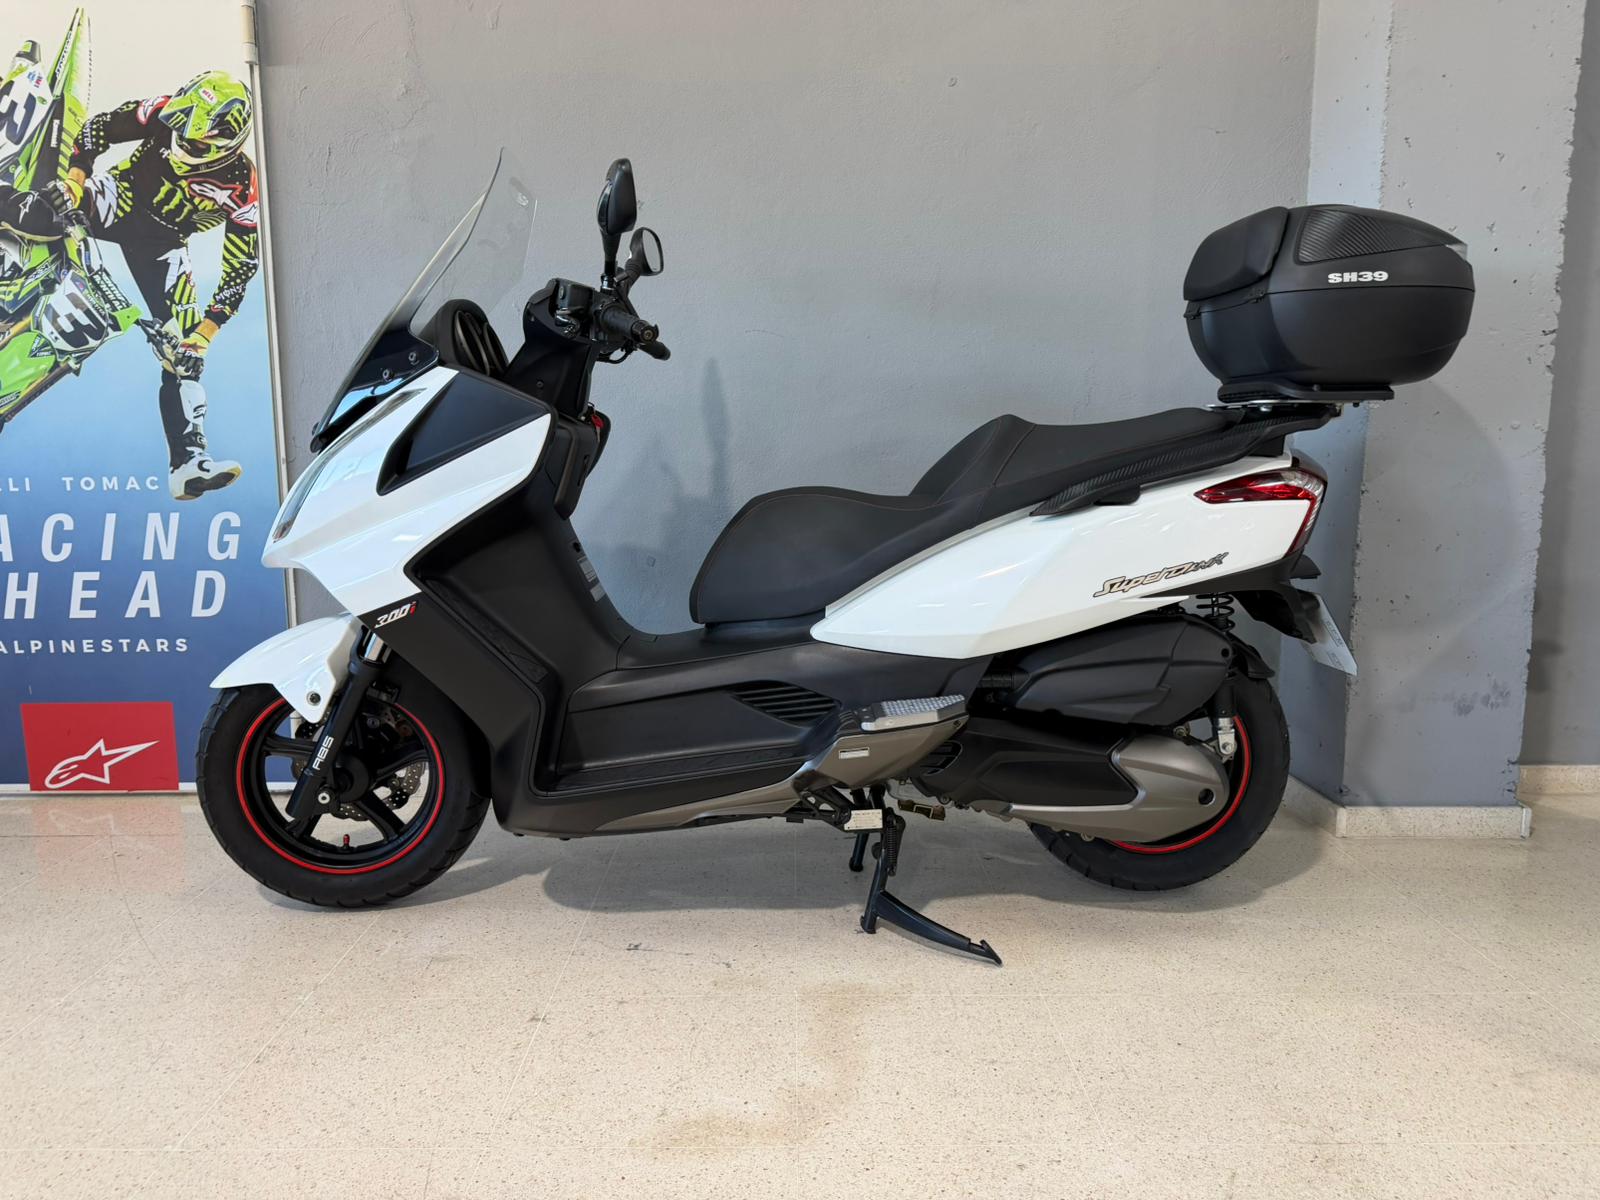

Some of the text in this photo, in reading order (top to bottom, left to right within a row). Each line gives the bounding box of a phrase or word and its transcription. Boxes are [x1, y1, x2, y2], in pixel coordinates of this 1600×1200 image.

[1327, 270, 1389, 284] SH39
[0, 476, 159, 492] LI TOMAC
[4, 570, 226, 619] HEAD
[374, 601, 417, 629] 300i
[312, 735, 335, 771] ABS
